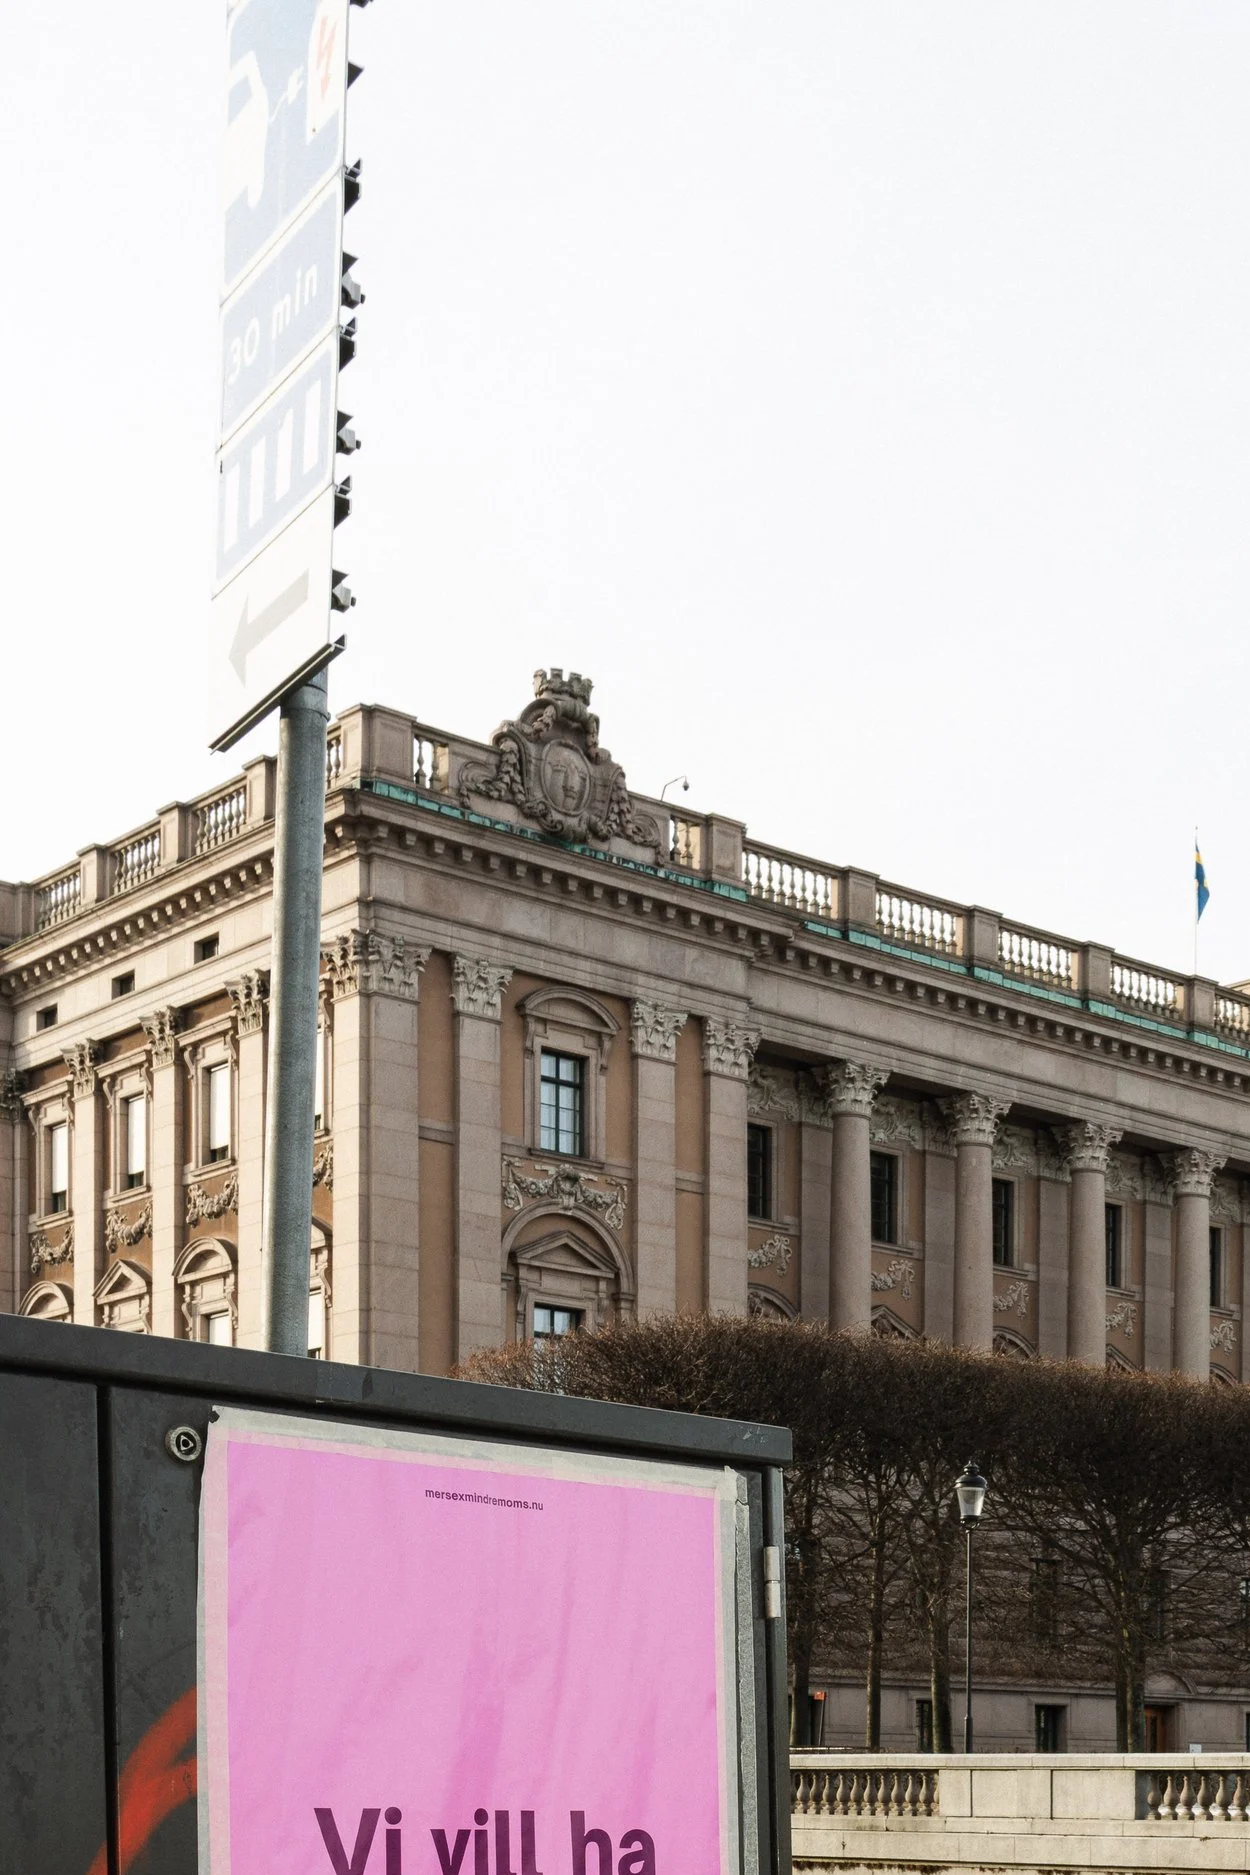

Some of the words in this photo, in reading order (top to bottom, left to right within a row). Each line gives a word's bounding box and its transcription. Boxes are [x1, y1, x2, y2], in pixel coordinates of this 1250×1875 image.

[228, 317, 260, 385] 30
[271, 264, 318, 340] min
[425, 1488, 544, 1511] mersexmindremoms.nu
